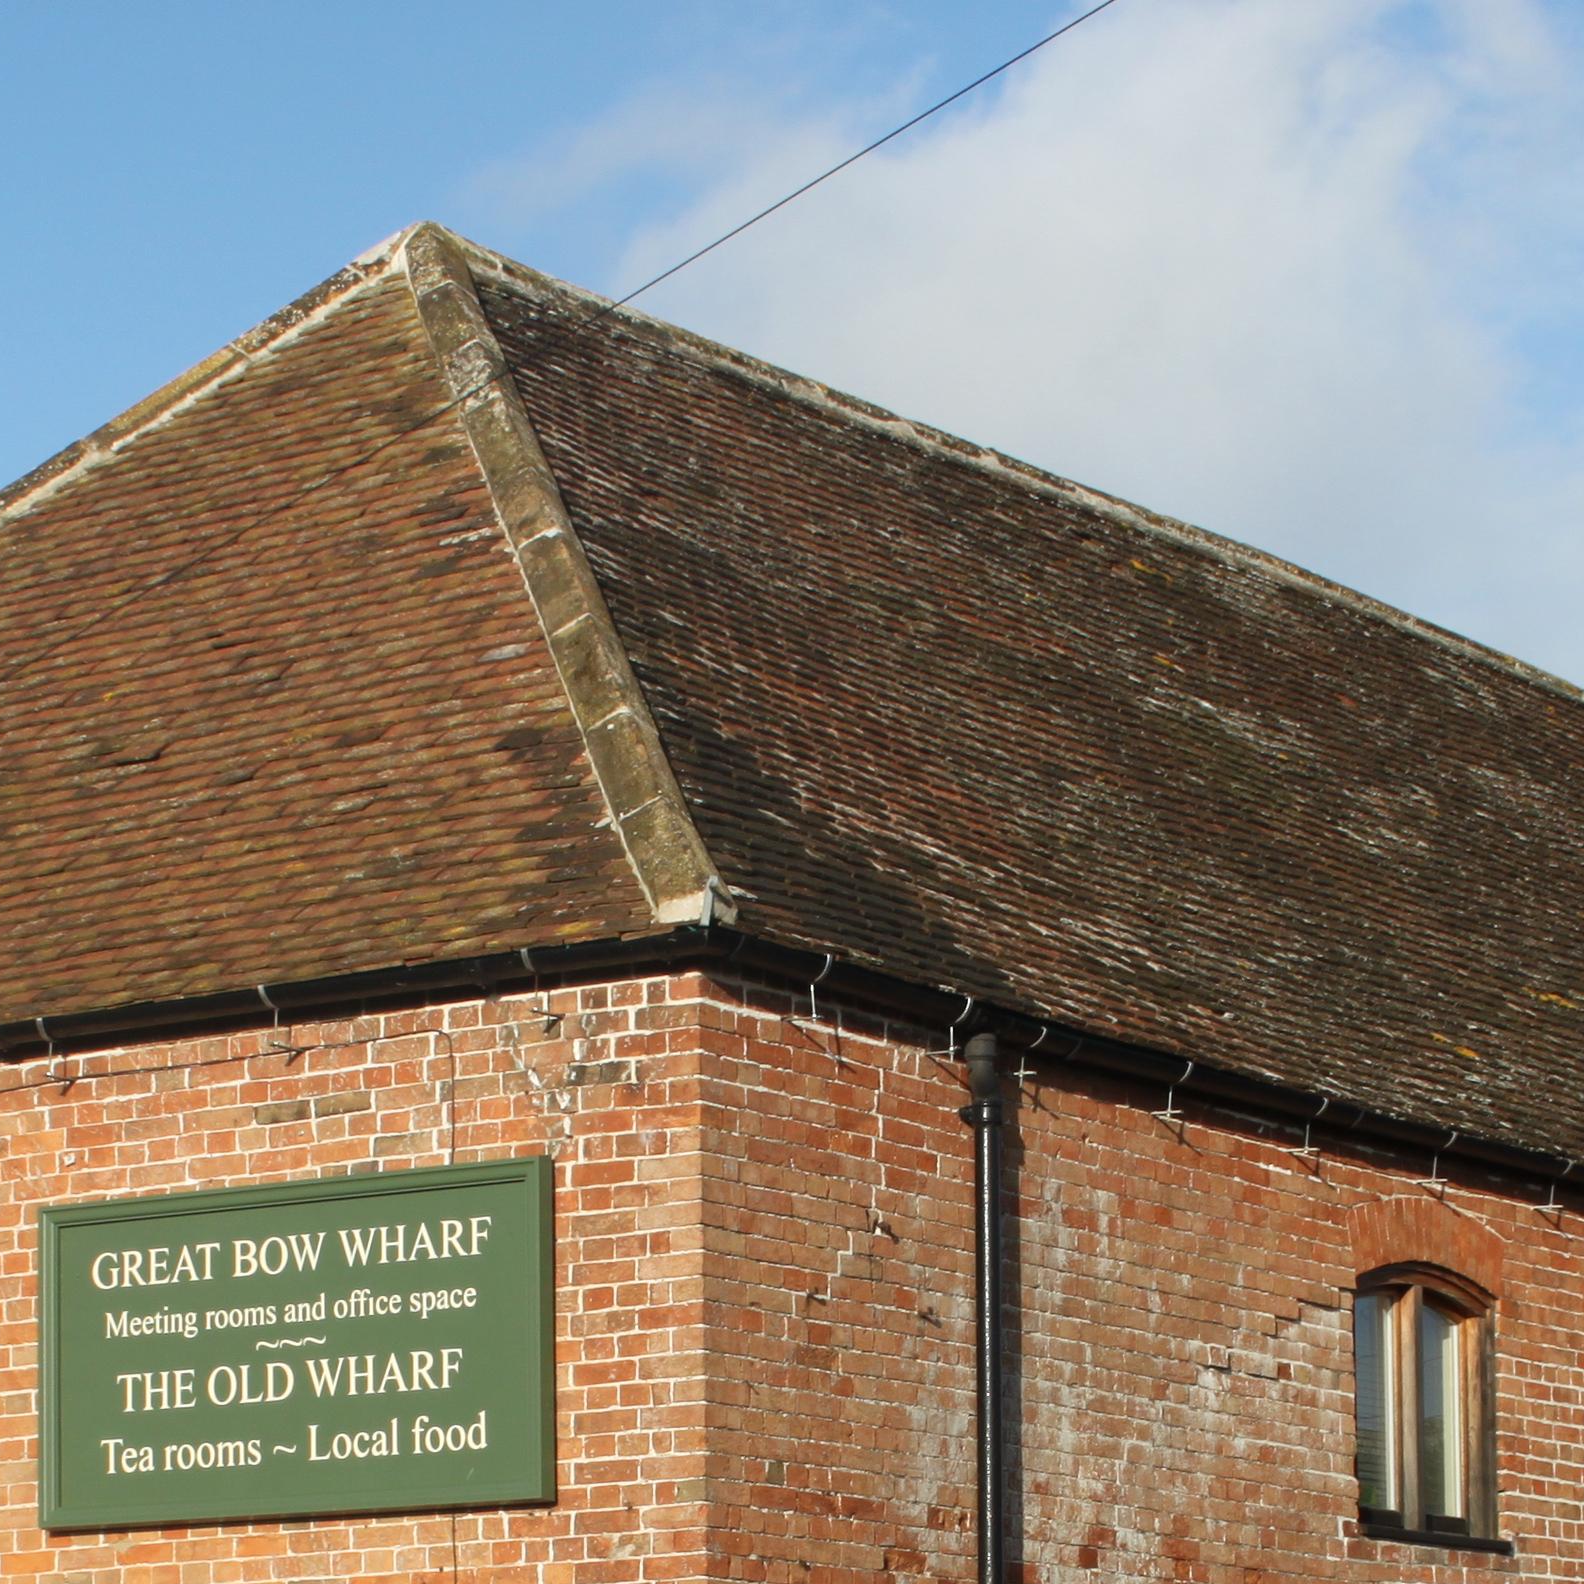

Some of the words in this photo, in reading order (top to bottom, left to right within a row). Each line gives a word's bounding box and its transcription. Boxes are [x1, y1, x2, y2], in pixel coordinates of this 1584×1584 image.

[91, 1242, 221, 1290] GREAT
[231, 1231, 327, 1278] BOW
[337, 1215, 492, 1268] WHARF
[104, 1306, 199, 1339] Meeting
[204, 1305, 277, 1330] rooms
[283, 1292, 326, 1324] and
[333, 1288, 402, 1319] office
[409, 1287, 477, 1320] space
[116, 1368, 197, 1413] THE
[207, 1362, 295, 1406] OLD
[305, 1347, 463, 1398] WHARF
[100, 1438, 155, 1475] Tea
[163, 1439, 262, 1471] rooms
[307, 1417, 400, 1462] Local
[411, 1409, 488, 1455] food
